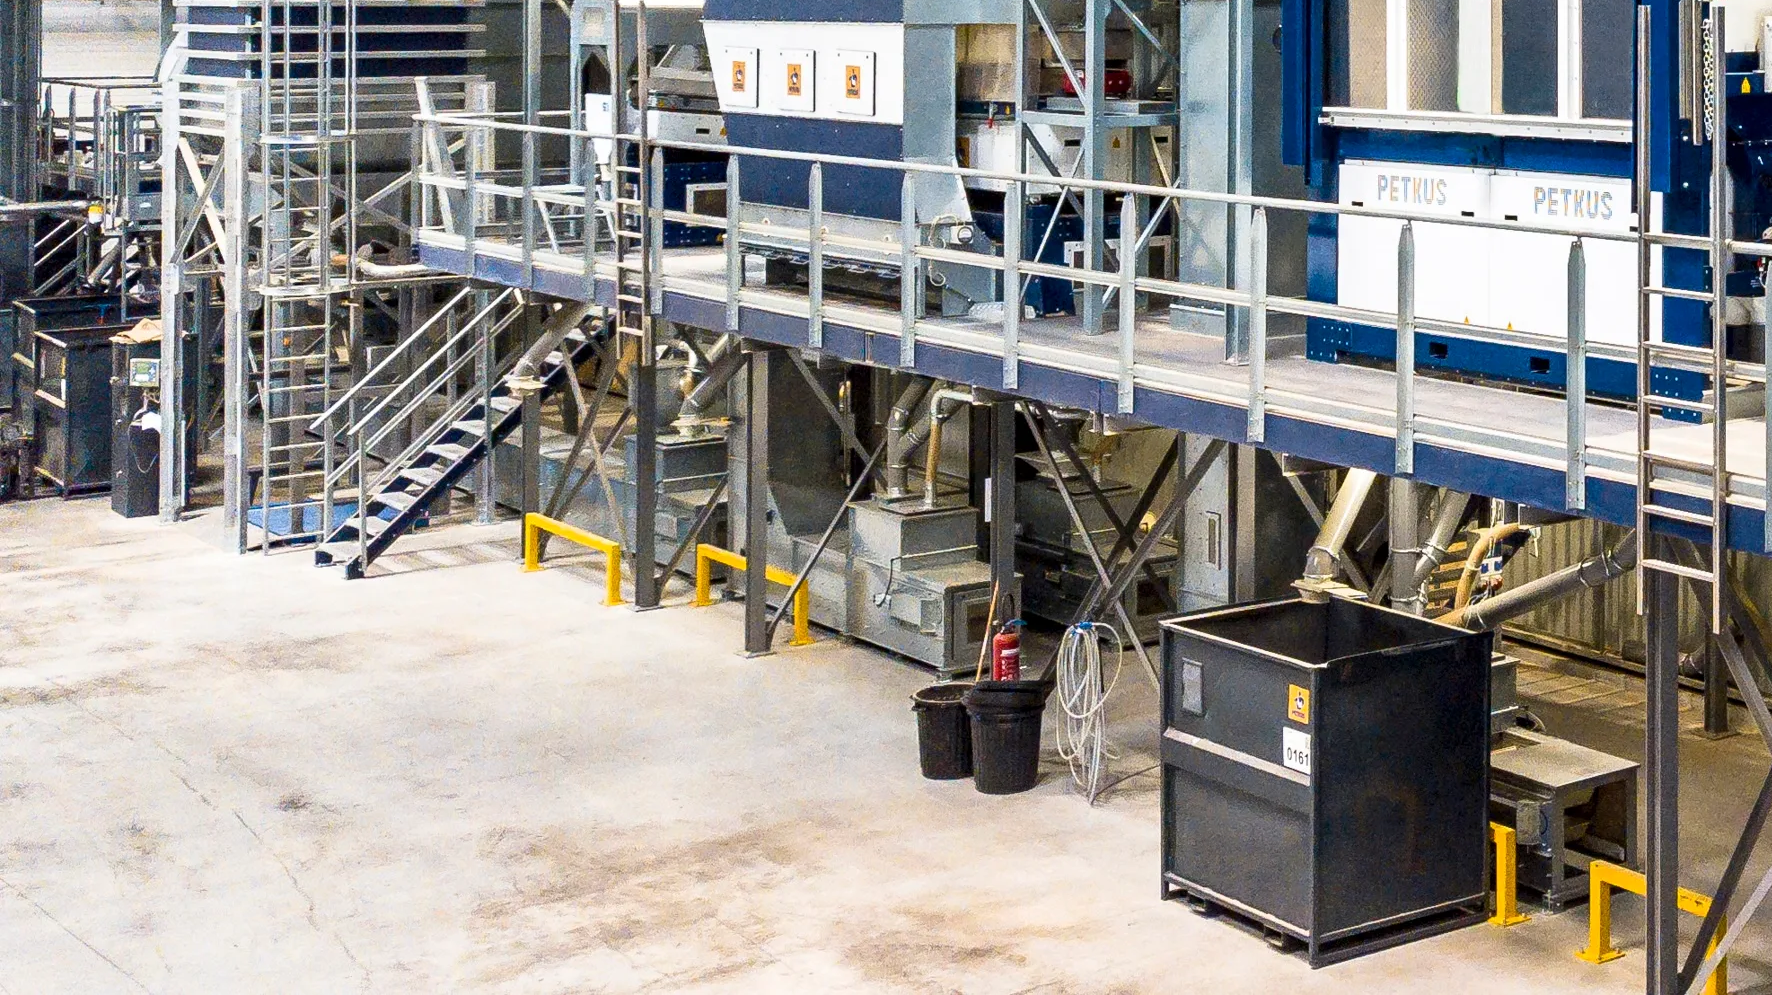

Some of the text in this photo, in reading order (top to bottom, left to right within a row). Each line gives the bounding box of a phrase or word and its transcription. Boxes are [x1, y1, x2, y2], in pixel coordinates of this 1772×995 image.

[1377, 174, 1448, 205] PETKUS
[1534, 186, 1613, 220] PETKUS
[1287, 747, 1309, 766] 0161
